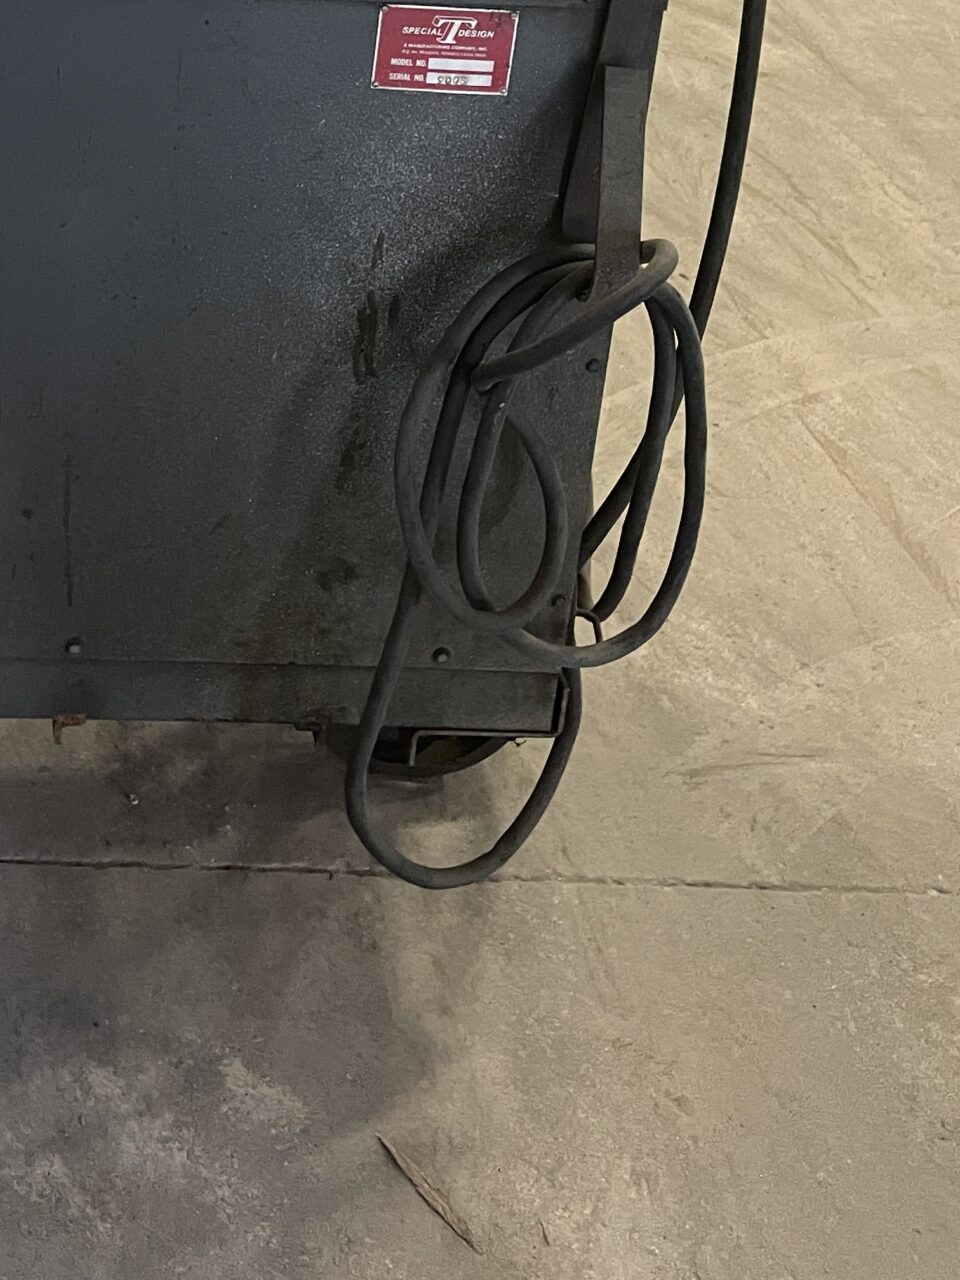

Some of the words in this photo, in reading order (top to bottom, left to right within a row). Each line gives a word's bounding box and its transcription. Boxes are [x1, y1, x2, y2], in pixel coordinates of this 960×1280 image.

[402, 26, 442, 36] SPECIAL
[458, 30, 495, 38] DESIGN
[390, 58, 413, 66] MODEL
[389, 73, 411, 81] SERIAL
